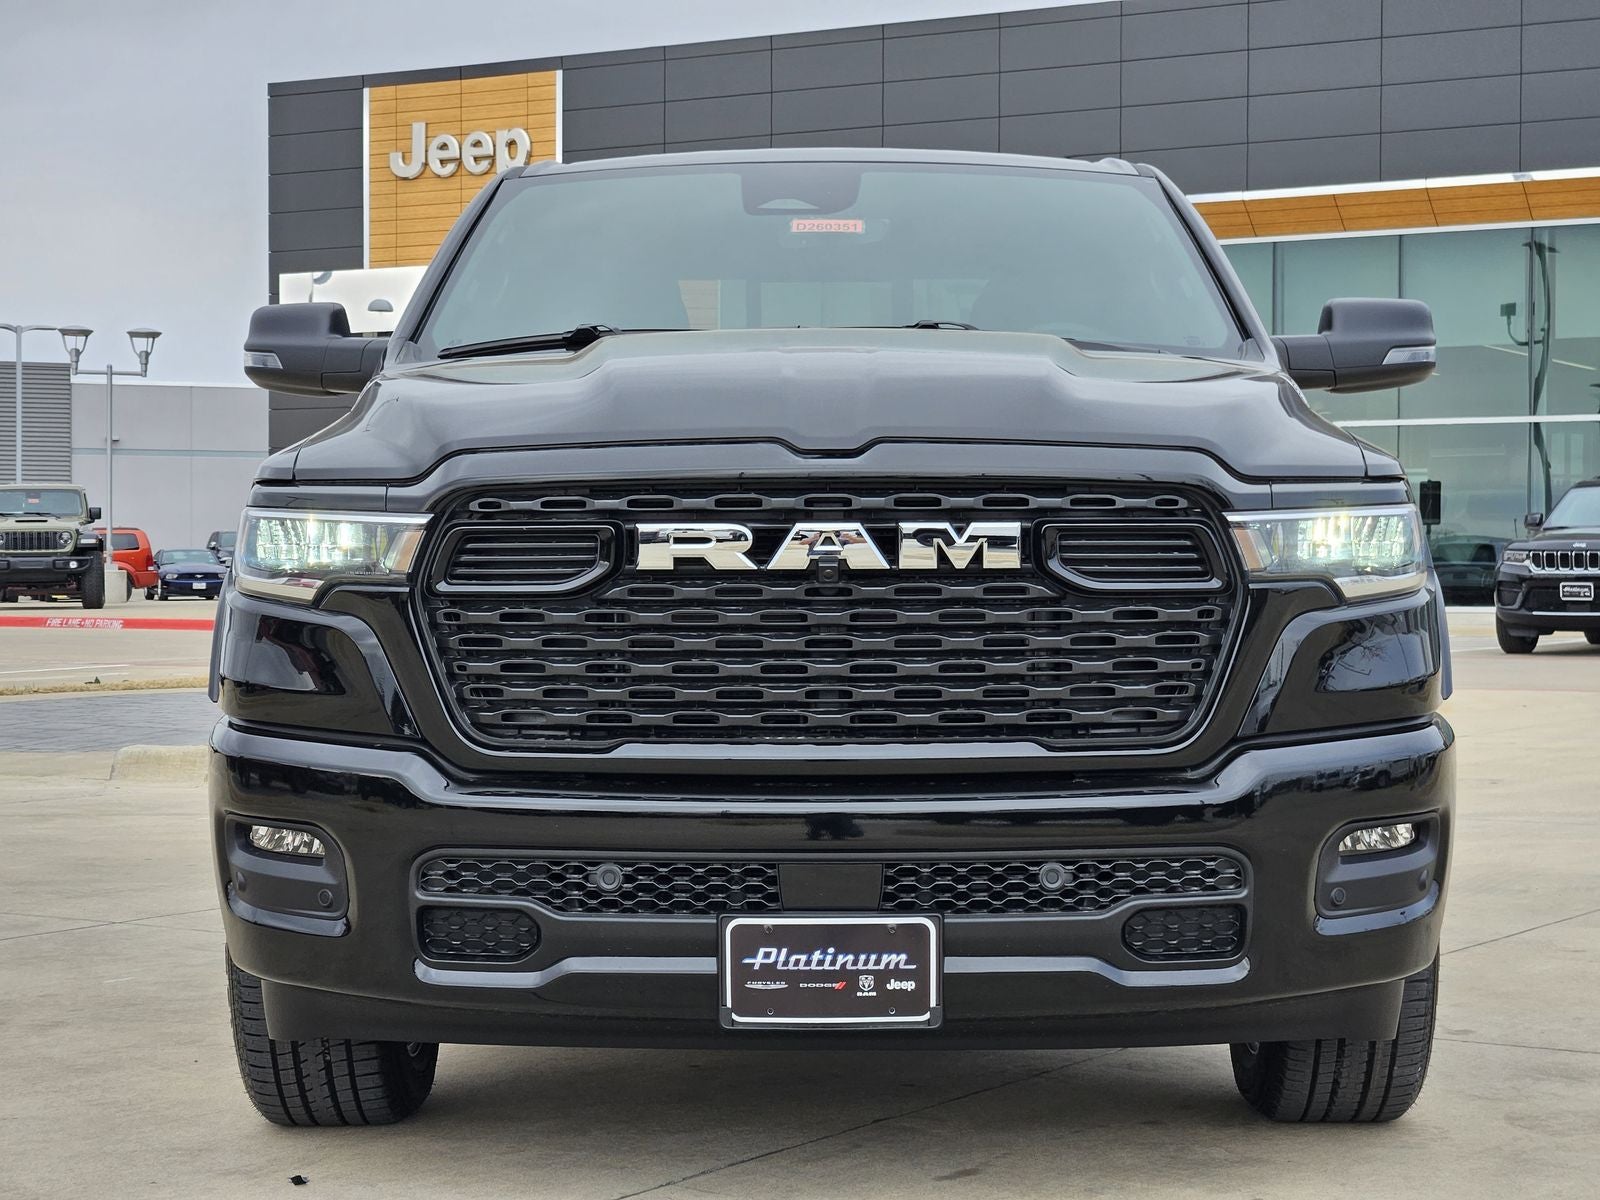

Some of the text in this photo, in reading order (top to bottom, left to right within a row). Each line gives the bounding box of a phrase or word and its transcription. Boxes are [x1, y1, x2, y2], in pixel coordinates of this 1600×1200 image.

[389, 121, 531, 179] Jeep
[796, 223, 858, 231] D260351
[636, 522, 1021, 570] RAM
[742, 947, 916, 970] Platinum
[886, 978, 915, 992] Jeep
